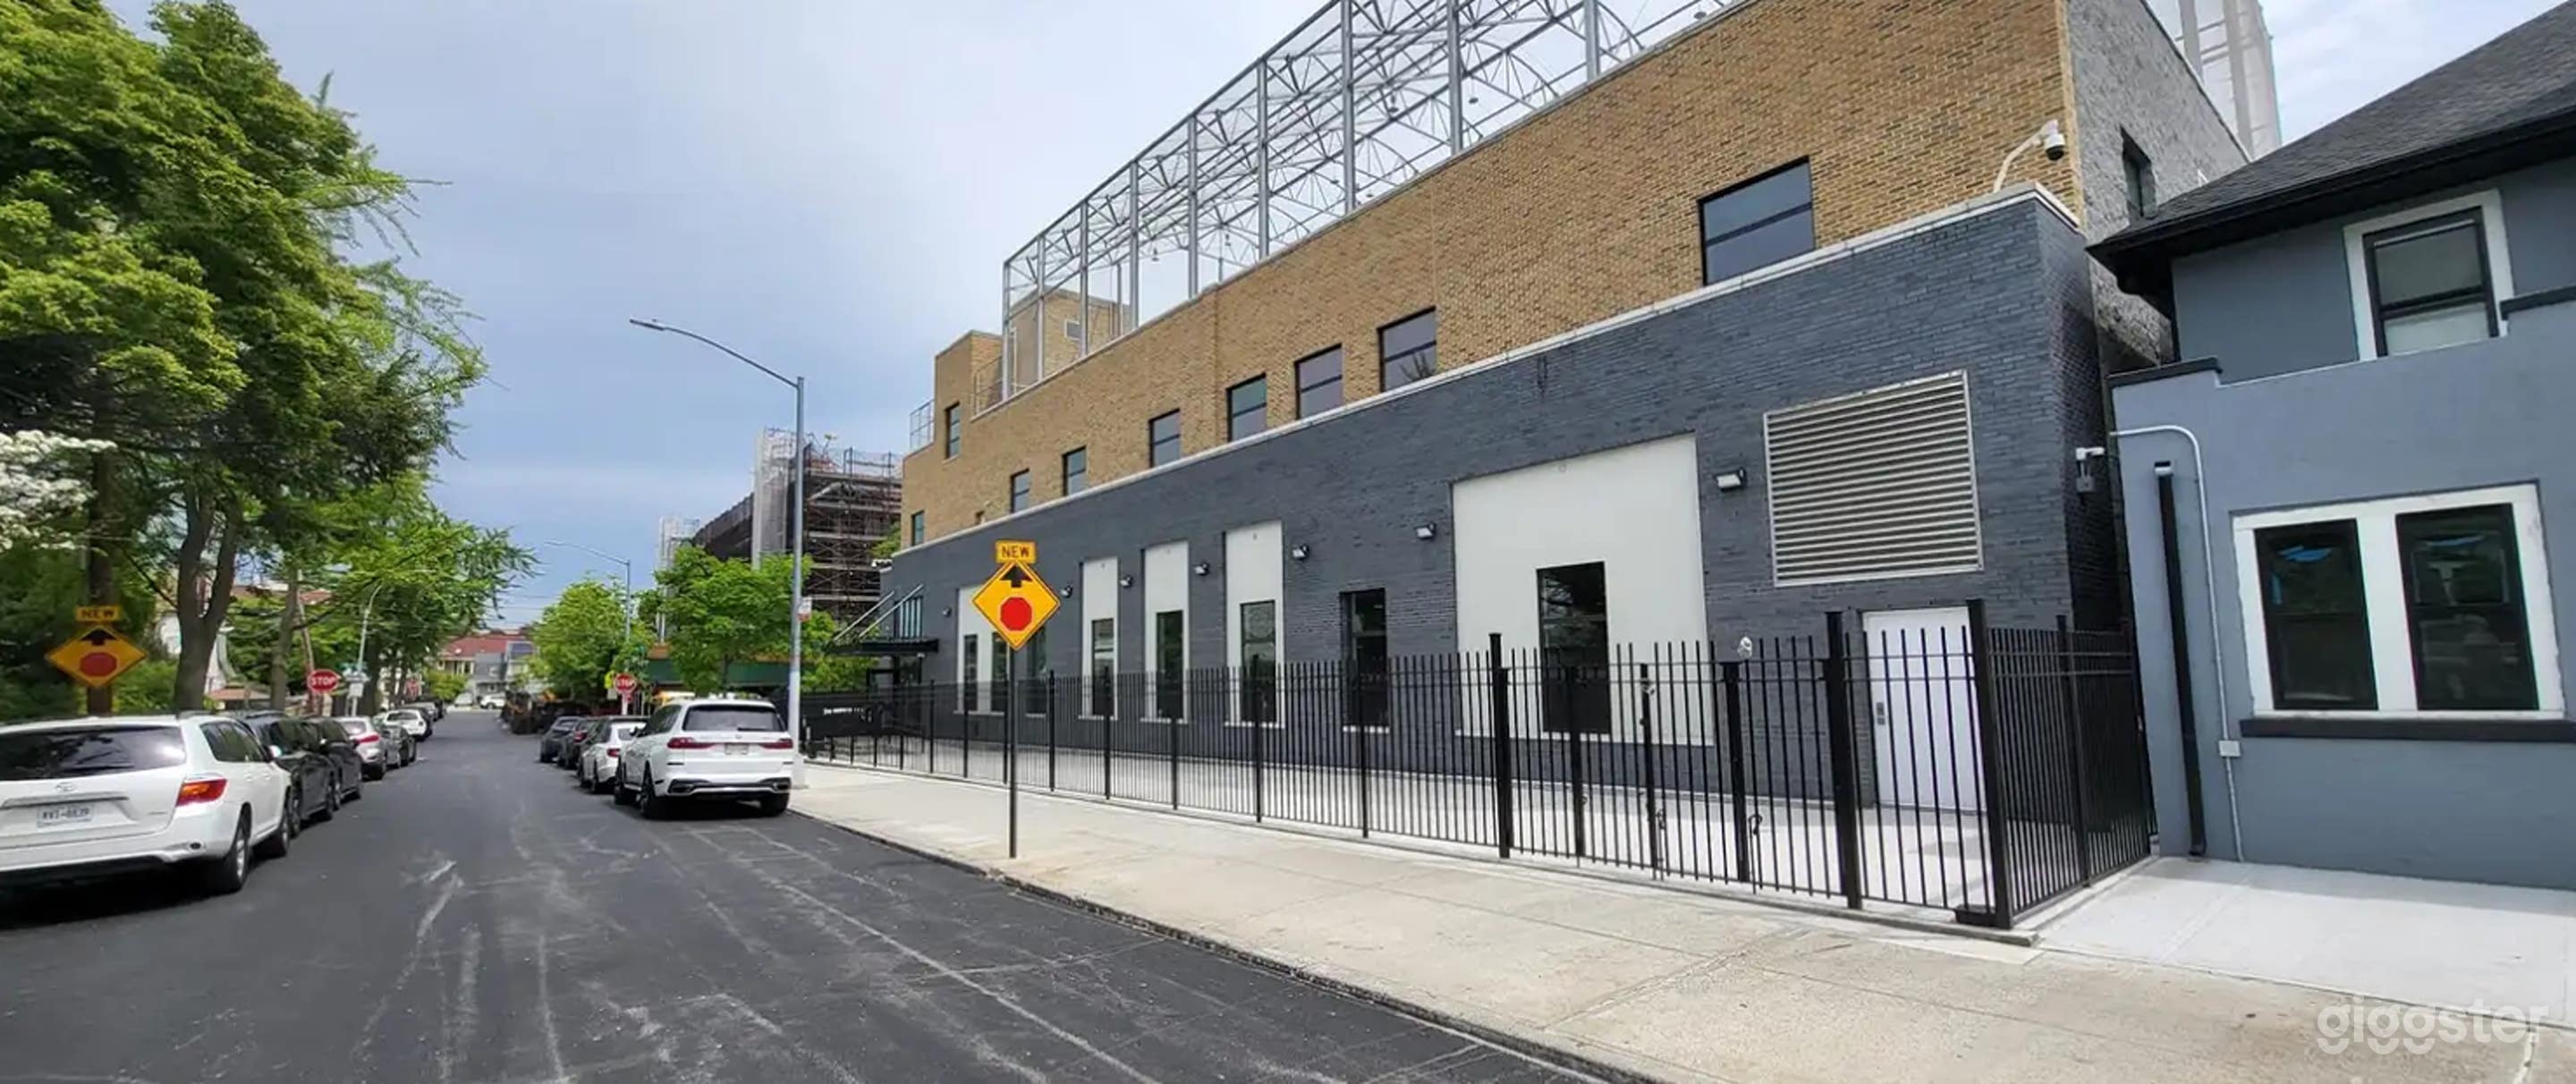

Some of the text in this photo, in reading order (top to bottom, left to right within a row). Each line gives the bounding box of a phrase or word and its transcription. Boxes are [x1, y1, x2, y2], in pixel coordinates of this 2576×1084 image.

[1001, 545, 1030, 558] NEW
[81, 609, 114, 619] NEW
[310, 676, 336, 686] STOP
